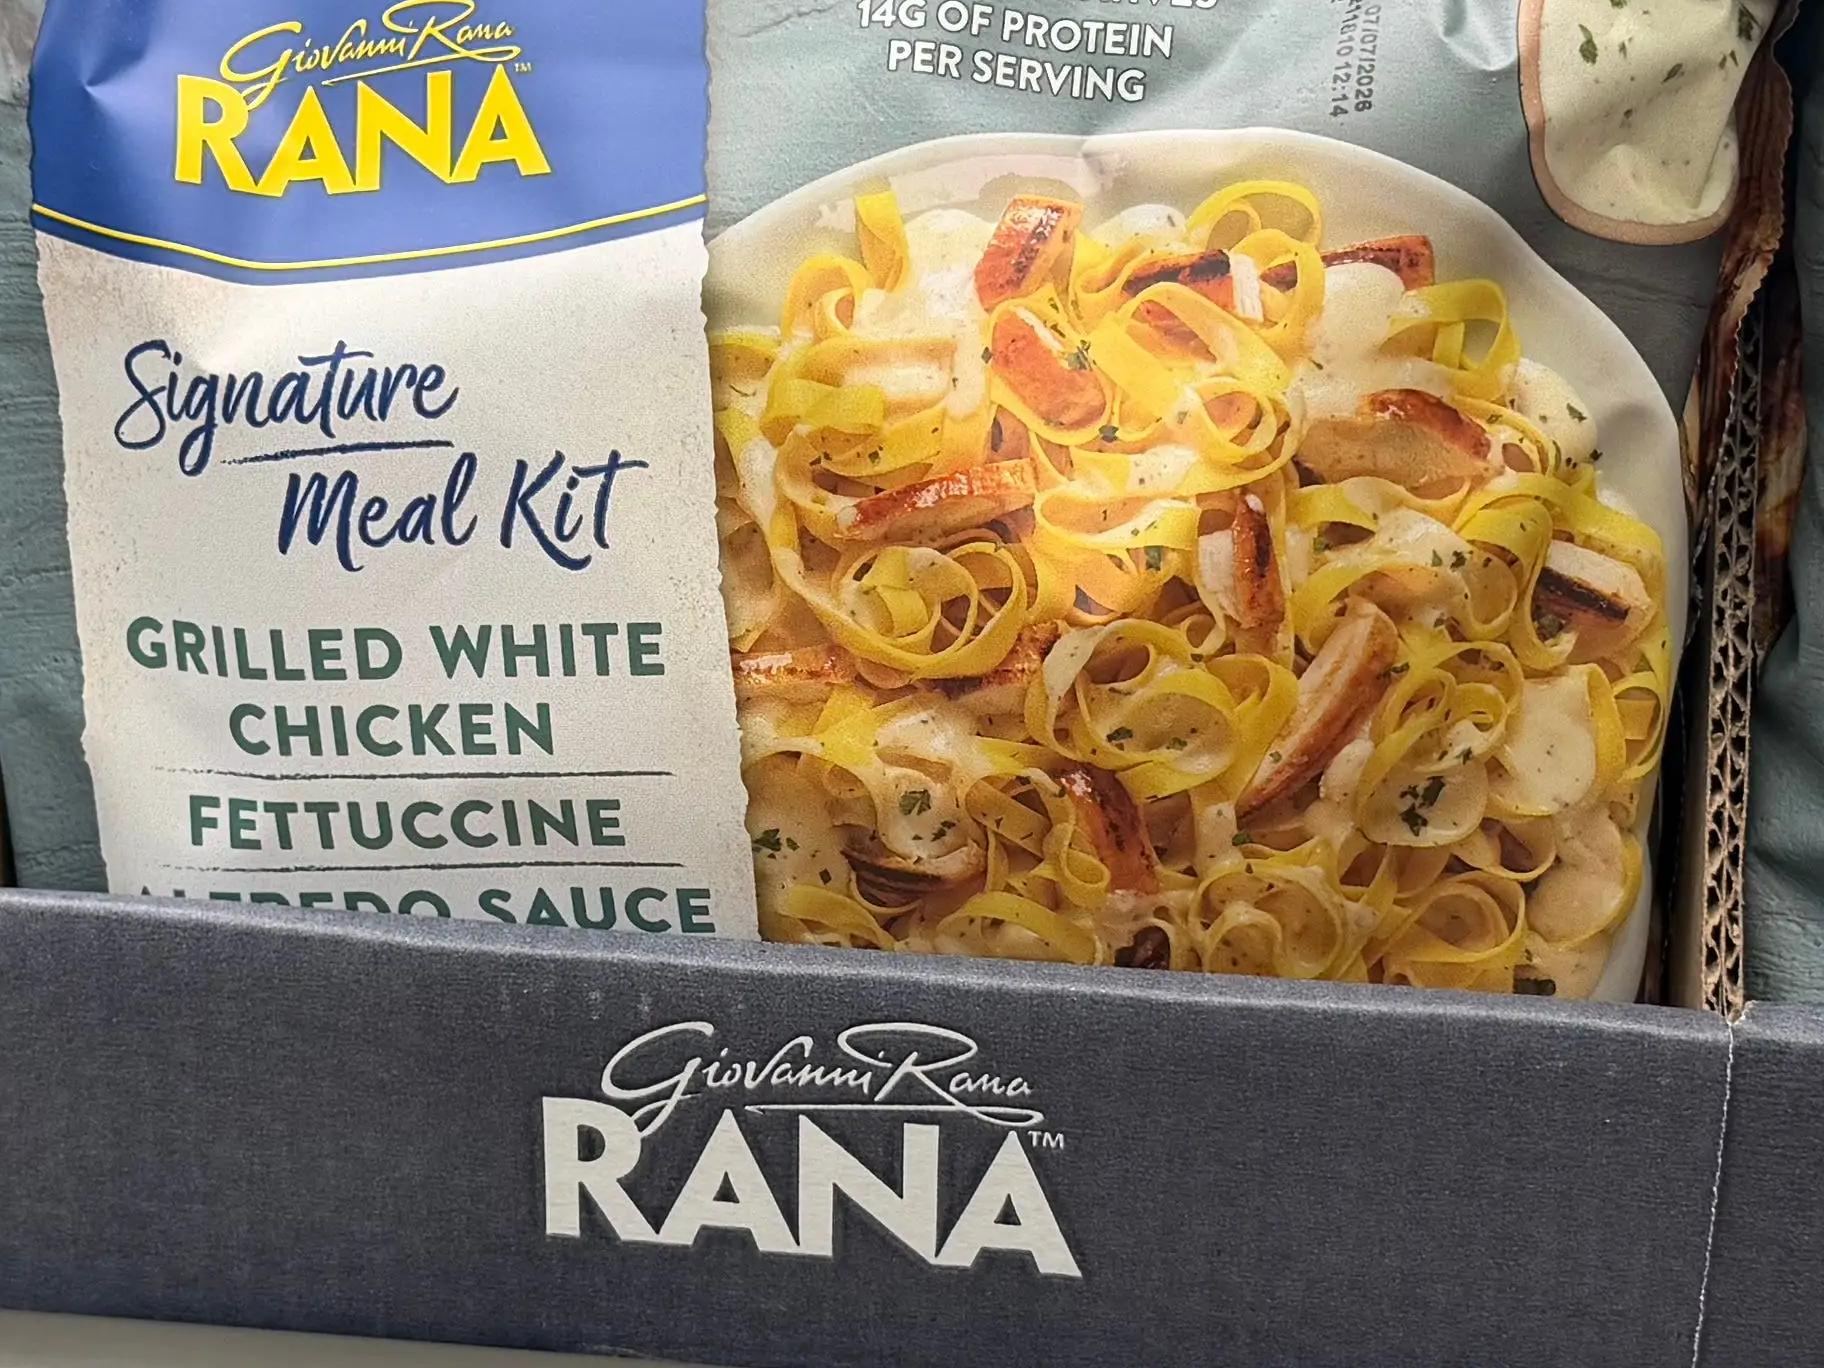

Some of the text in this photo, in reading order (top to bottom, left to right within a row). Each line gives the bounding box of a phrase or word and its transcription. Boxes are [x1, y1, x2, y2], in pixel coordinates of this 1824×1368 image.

[936, 2, 995, 36] OF
[1000, 10, 1174, 60] PROTEIN
[886, 40, 1147, 104] PER SERVING
[174, 63, 552, 197] RANA
[114, 339, 459, 473] Signature
[276, 450, 651, 573] Meal Kit
[126, 616, 665, 682] GRILLED WHITE
[229, 702, 555, 757] CHICKEN
[188, 795, 626, 850] FETTUCCINE
[478, 887, 716, 934] SAUCE
[541, 1095, 1082, 1278] RANA
